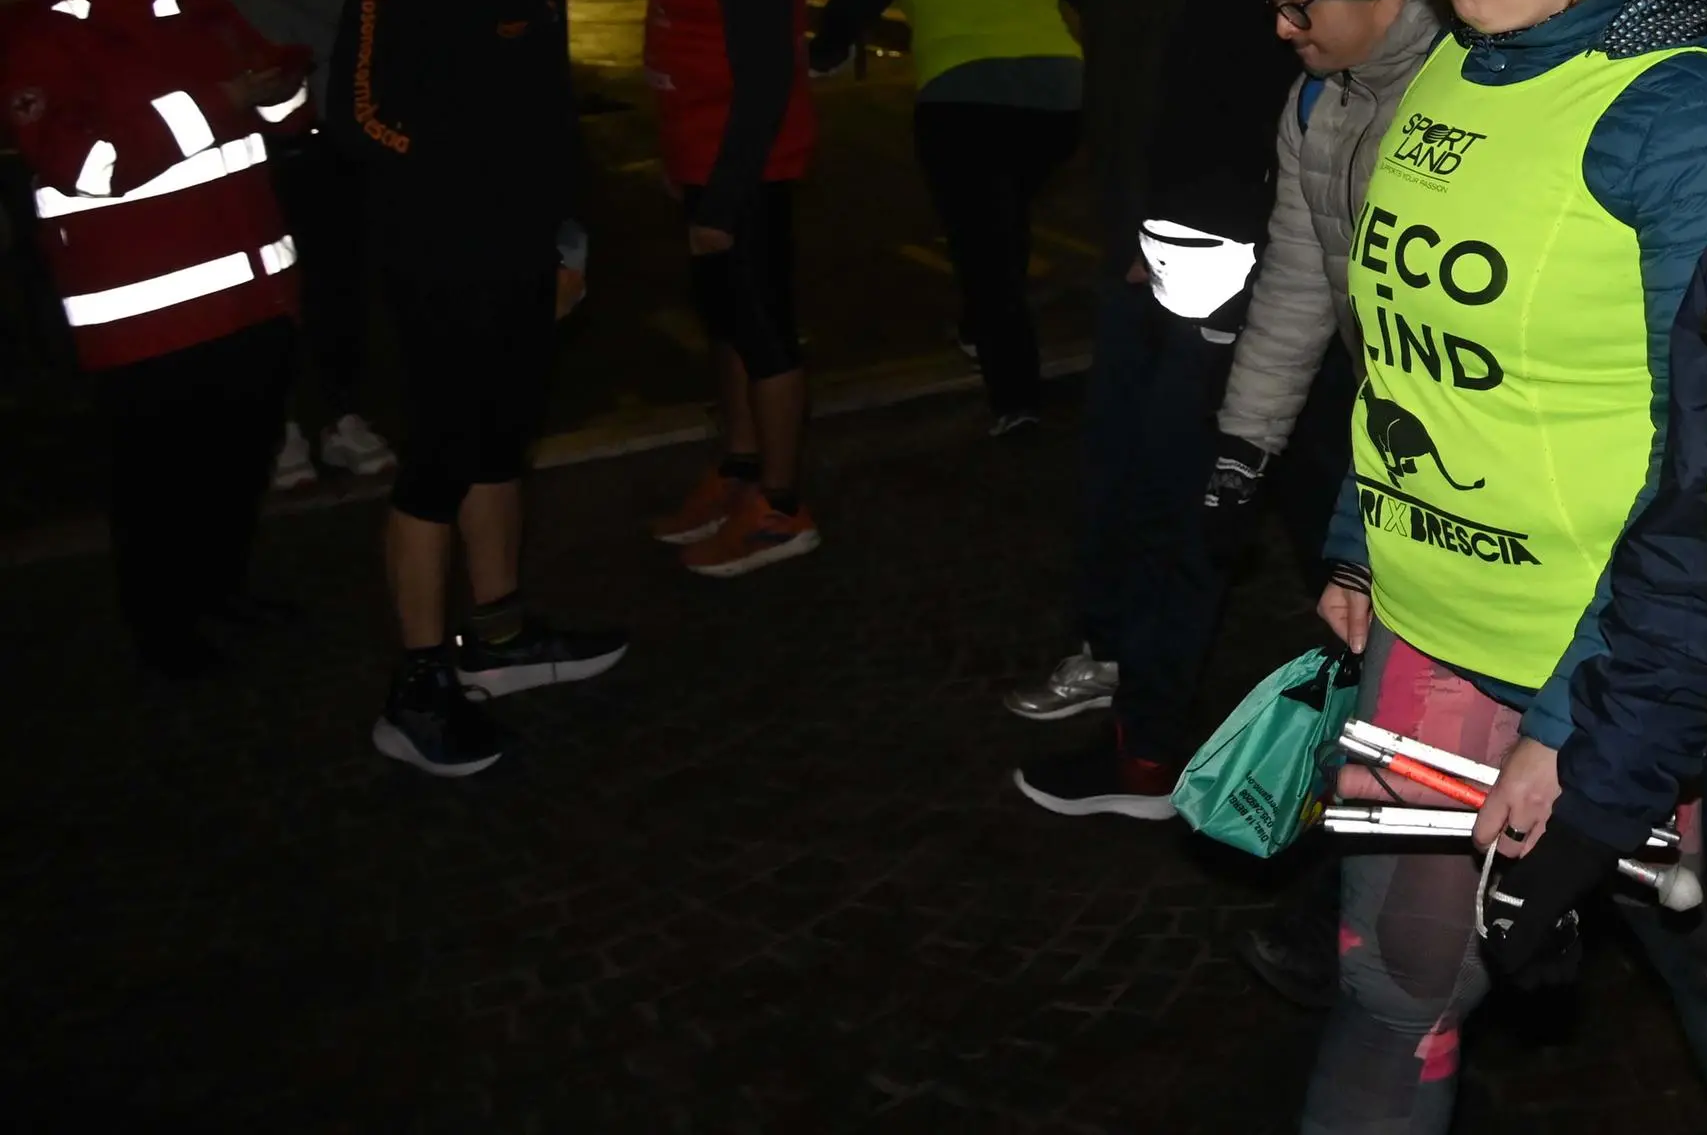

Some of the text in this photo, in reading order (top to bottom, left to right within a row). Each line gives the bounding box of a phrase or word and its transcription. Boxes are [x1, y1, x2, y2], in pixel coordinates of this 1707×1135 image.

[1393, 134, 1463, 176] LAND
[1401, 112, 1488, 157] SPORT
[1352, 201, 1509, 306] IECO
[1352, 294, 1504, 391] LIND
